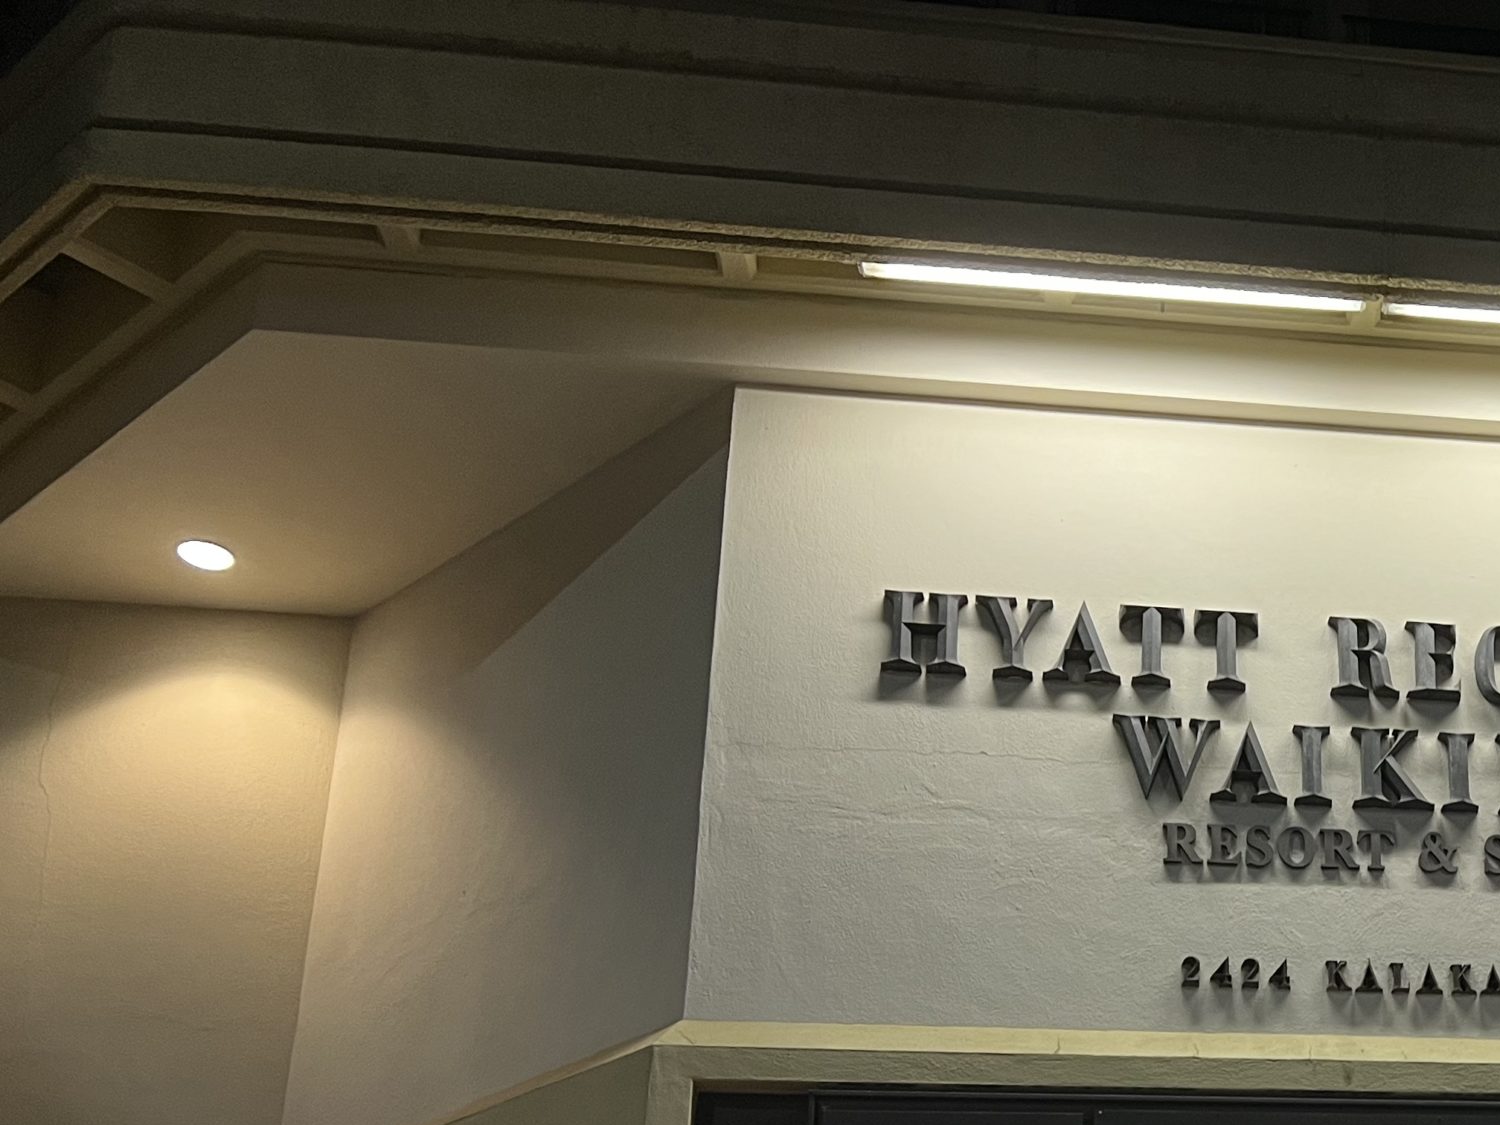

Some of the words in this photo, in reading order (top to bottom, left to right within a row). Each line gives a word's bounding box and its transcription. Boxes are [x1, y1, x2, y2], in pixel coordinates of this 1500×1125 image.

[883, 588, 1259, 694] HYATT
[1162, 820, 1395, 872] RESORT
[1417, 831, 1459, 875] &
[1180, 955, 1292, 991] 2424
